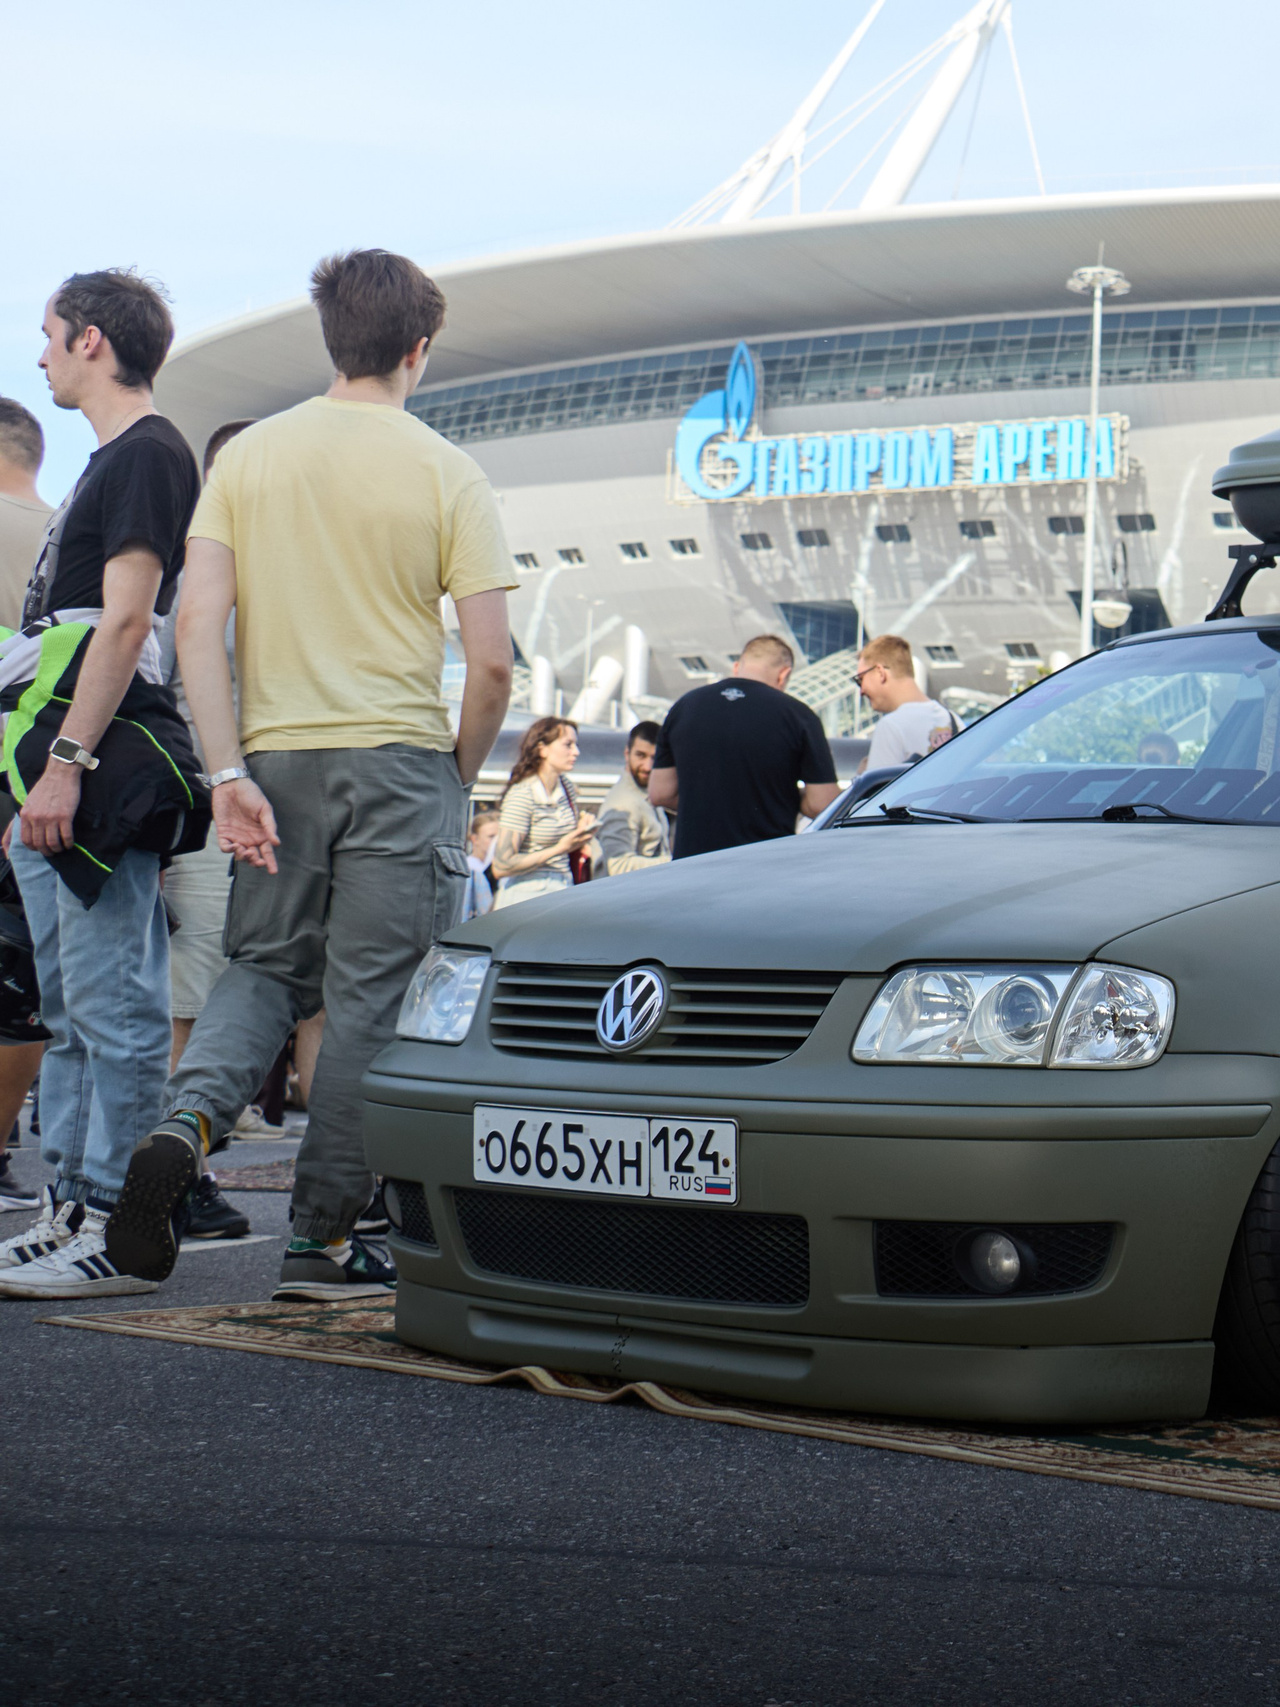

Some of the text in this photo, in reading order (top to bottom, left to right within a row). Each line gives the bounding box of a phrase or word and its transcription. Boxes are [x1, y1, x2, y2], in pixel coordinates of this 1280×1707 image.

[754, 417, 1115, 497] ГАЗПРОМ АРЕНА
[652, 1127, 720, 1175] 124
[669, 1175, 704, 1191] RUS
